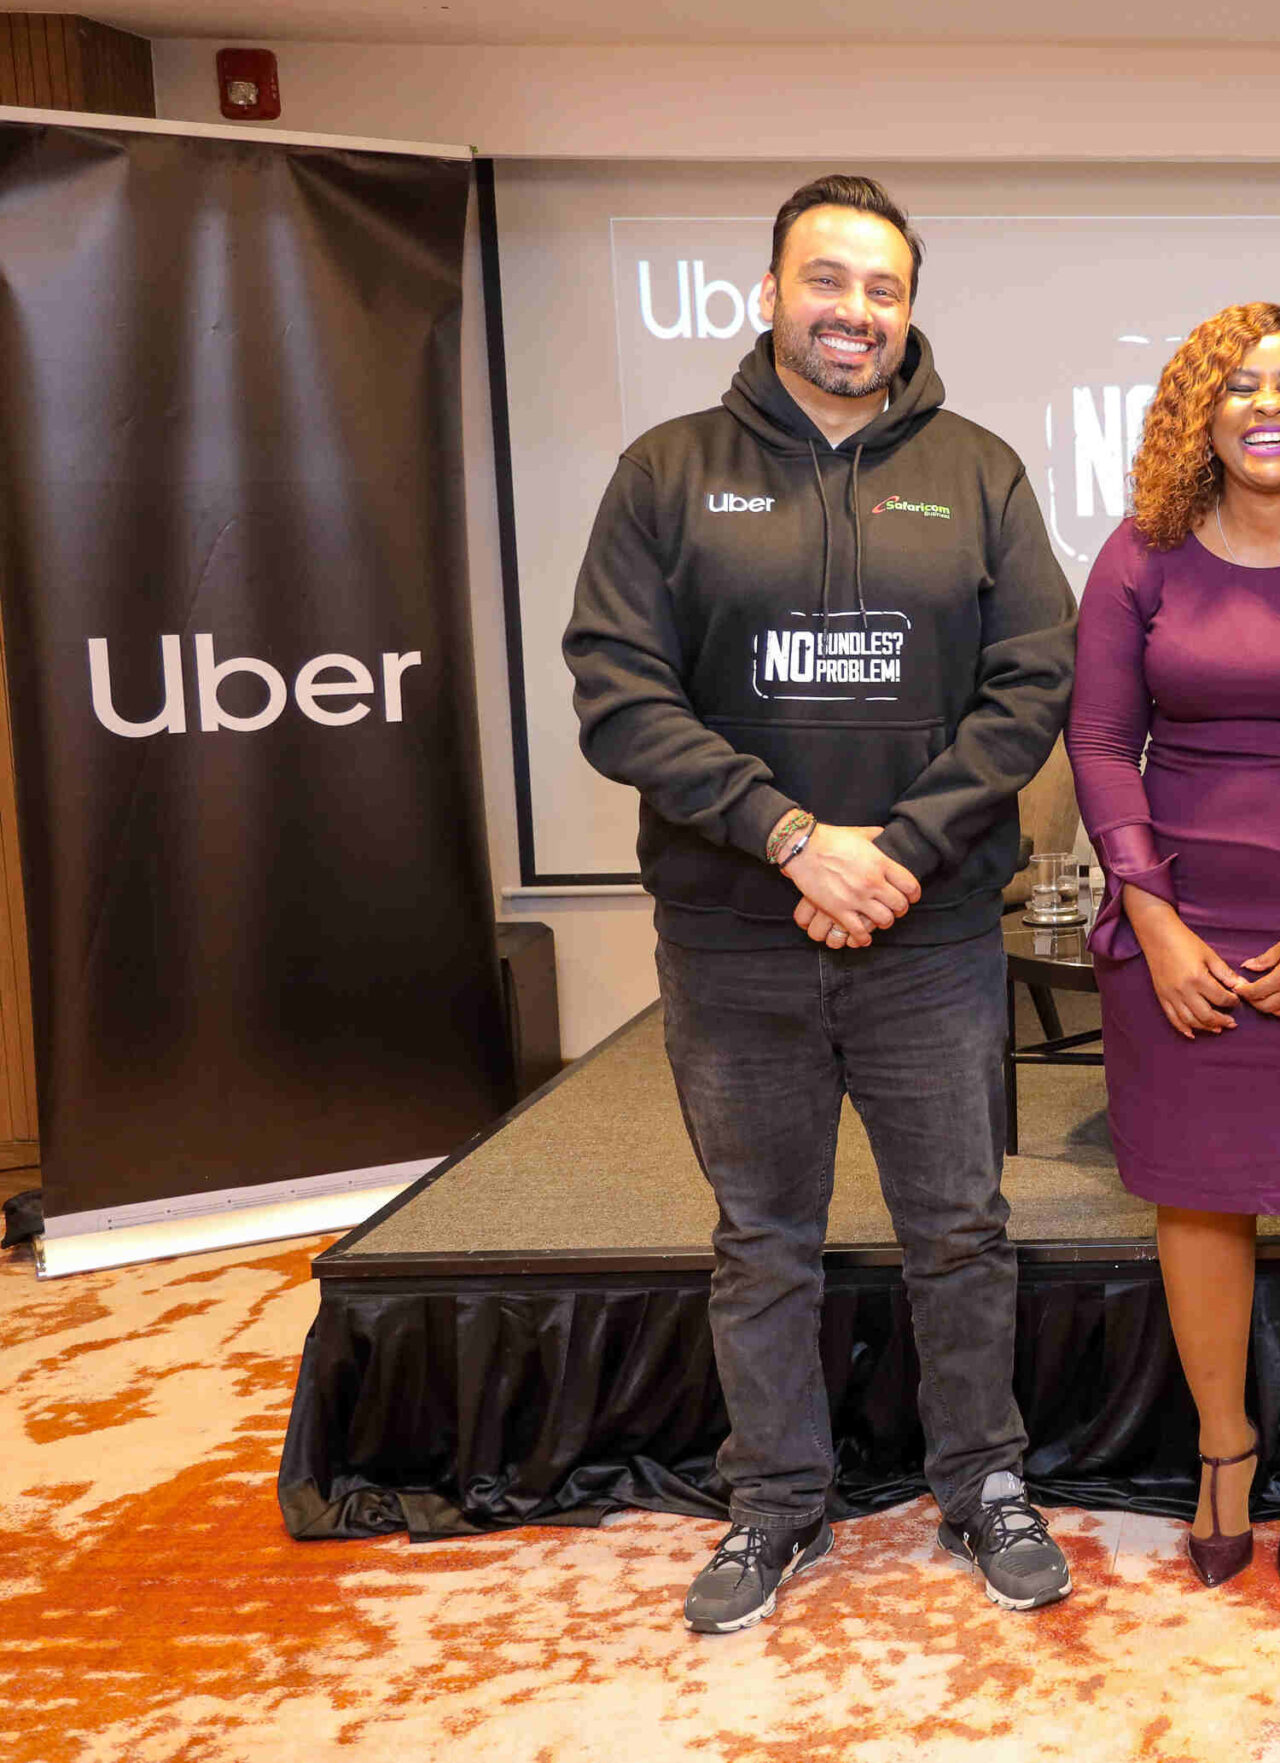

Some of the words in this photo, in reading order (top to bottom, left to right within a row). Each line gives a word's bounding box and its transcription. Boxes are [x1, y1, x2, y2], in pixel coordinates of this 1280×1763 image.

[638, 260, 773, 339] Ub
[708, 493, 775, 513] Uber
[885, 500, 951, 514] Safaricom
[764, 630, 815, 683] NO
[815, 659, 901, 683] PROBLEM!
[88, 633, 422, 738] Uber
